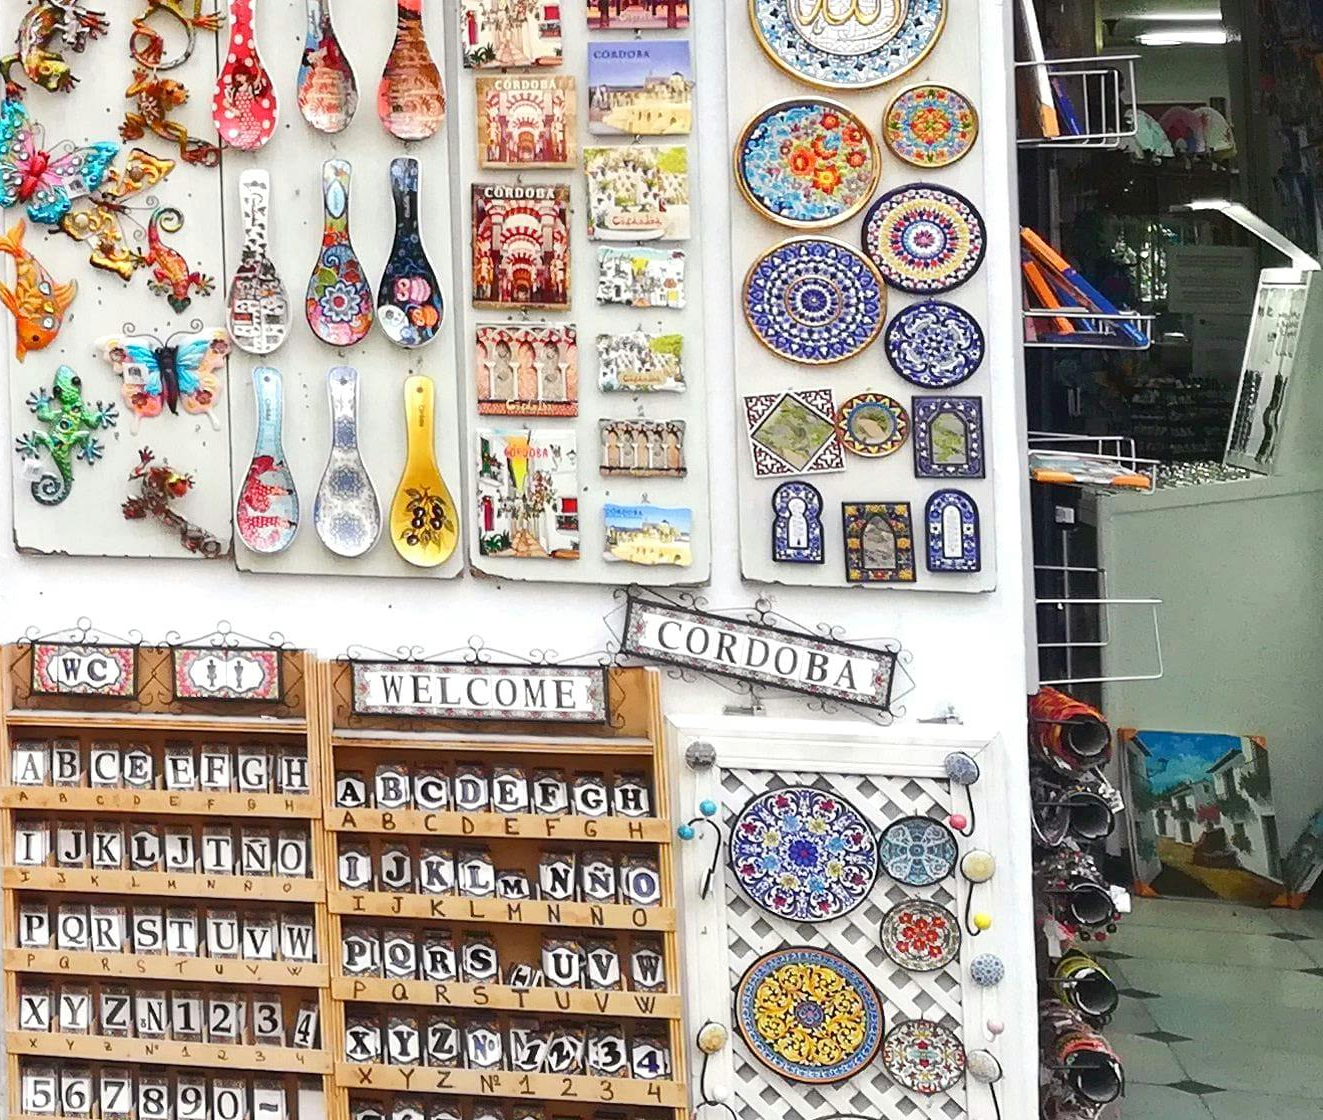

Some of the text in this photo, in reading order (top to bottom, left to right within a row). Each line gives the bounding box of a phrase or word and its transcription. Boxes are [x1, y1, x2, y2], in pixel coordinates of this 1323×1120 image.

[62, 657, 107, 682] WC
[658, 620, 857, 691] CORDOBA
[381, 674, 576, 710] WELCOME
[21, 753, 40, 781] A
[57, 750, 78, 779] B
[94, 752, 117, 780] C
[129, 754, 148, 780] E
[169, 757, 190, 785] E
[204, 755, 226, 783] F
[241, 757, 264, 787] G
[19, 791, 294, 810] A B C D E F G H
[339, 777, 644, 811] A B C D E F G H
[341, 811, 644, 840] A B C D E F G H
[22, 831, 302, 871] I J K L J T Ñ O
[346, 856, 655, 897] I J K L M N Ñ O
[353, 897, 648, 927] I J K L M N Ñ O
[24, 914, 313, 956] P Q R S T U V W
[345, 939, 662, 980] P Q R S U V W
[353, 983, 655, 1012] P Q R S T U V W
[23, 997, 48, 1026] X
[62, 996, 86, 1026] Y
[104, 997, 128, 1028] Z
[177, 1002, 196, 1031] 1
[211, 1003, 233, 1034] 2
[257, 1003, 279, 1034] 3
[297, 1012, 311, 1044] 4
[349, 1031, 371, 1055] X
[392, 1033, 415, 1057] Y
[432, 1028, 455, 1054] Z
[600, 1042, 621, 1067] 3
[637, 1050, 660, 1073] 4
[32, 1080, 51, 1108] 5
[64, 1080, 86, 1109] 6
[105, 1081, 125, 1109] 7
[142, 1088, 164, 1117] 8
[180, 1086, 203, 1116] 9
[358, 1067, 372, 1085] X
[403, 1069, 415, 1090] Y
[436, 1071, 453, 1088] Z
[520, 1075, 535, 1094] 1
[560, 1078, 577, 1097] 2
[599, 1080, 615, 1100] 3
[647, 1084, 661, 1103] 4
